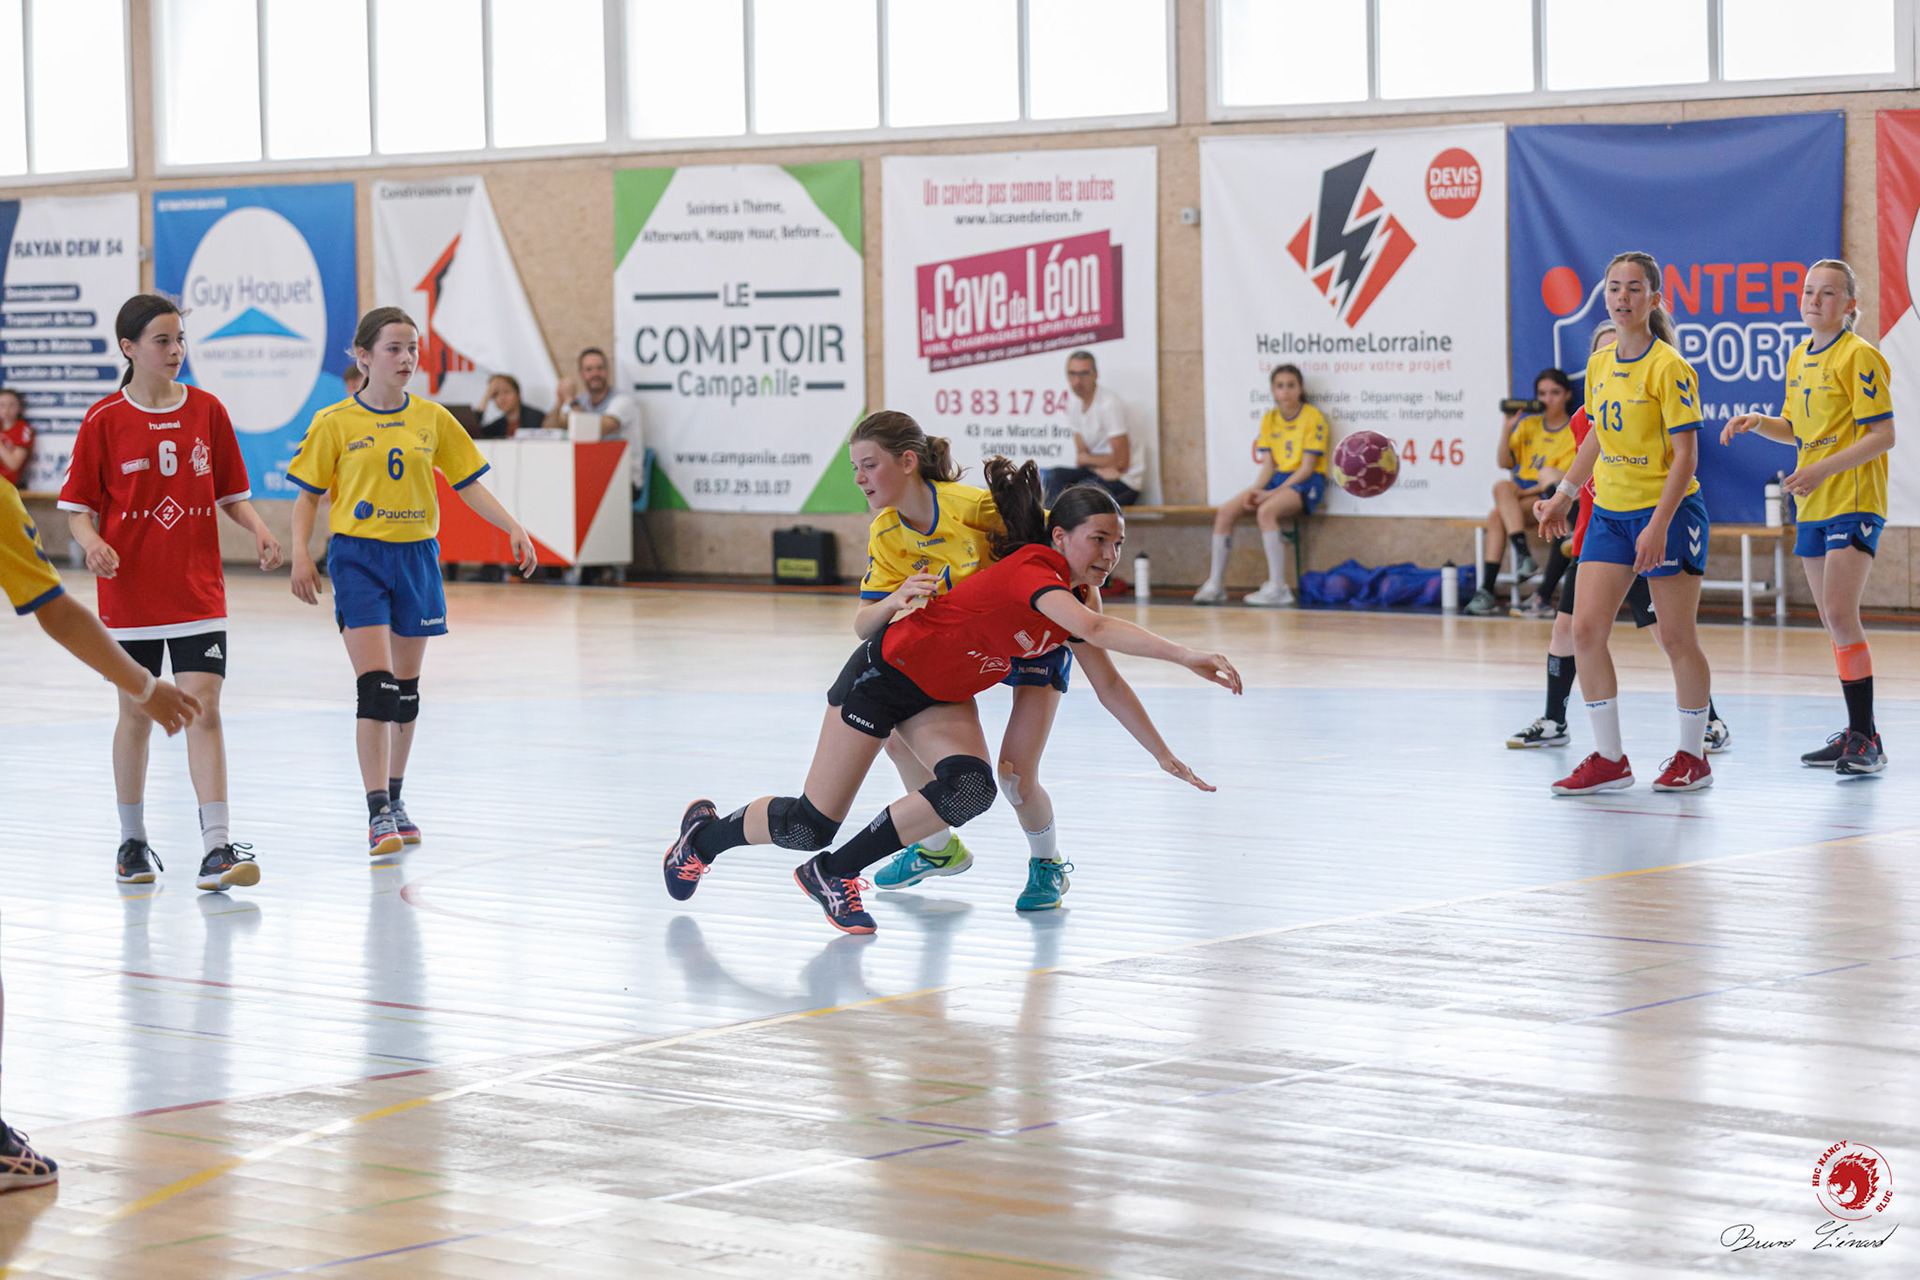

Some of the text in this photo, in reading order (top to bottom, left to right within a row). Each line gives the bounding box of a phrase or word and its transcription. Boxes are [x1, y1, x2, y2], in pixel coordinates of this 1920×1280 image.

[1429, 165, 1478, 186] DEVIS
[923, 173, 1115, 207] Un caviste pas comme les autres
[1429, 186, 1477, 200] GRATUIT
[954, 208, 1083, 226] www.lacavedeleon.fr
[14, 237, 123, 258] RAYAN DEM 54
[642, 228, 703, 244] Afterwork,
[706, 228, 744, 244] Happy
[748, 226, 778, 242] Hour,
[191, 274, 313, 313] Guy Hoquet
[723, 282, 750, 308] LE
[934, 263, 1008, 340] Cave
[1008, 289, 1027, 327] de
[1026, 242, 1100, 324] Léon
[1663, 262, 1808, 315] NTER
[635, 323, 845, 365] COMPTOIR
[952, 326, 1026, 350] CHAMPAGNES
[1028, 326, 1036, 337] &
[1038, 315, 1101, 336] SPIRITUEUX
[1256, 330, 1452, 355] HelloHomeLorraine
[1674, 321, 1812, 382] PORT
[1334, 361, 1364, 374] pour
[1370, 360, 1405, 372] votre
[1409, 358, 1452, 374] projet
[677, 368, 800, 406] Campanile
[1360, 390, 1423, 405] Dépannage
[1434, 388, 1464, 401] Neuf
[935, 389, 1069, 415] 03 83 17 84
[1332, 407, 1389, 423] Diagnostic
[1399, 406, 1464, 422] Interphone
[1599, 399, 1623, 432] 13
[983, 426, 1003, 438] rue
[1006, 423, 1047, 438] Marcel
[158, 440, 178, 476] 6
[674, 450, 813, 468] www.campanile.com
[980, 443, 1063, 458] 54000 NANCY
[1430, 438, 1464, 466] 46
[387, 447, 404, 480] 6
[1018, 665, 1049, 676] hummel
[848, 713, 875, 730] ATORKA
